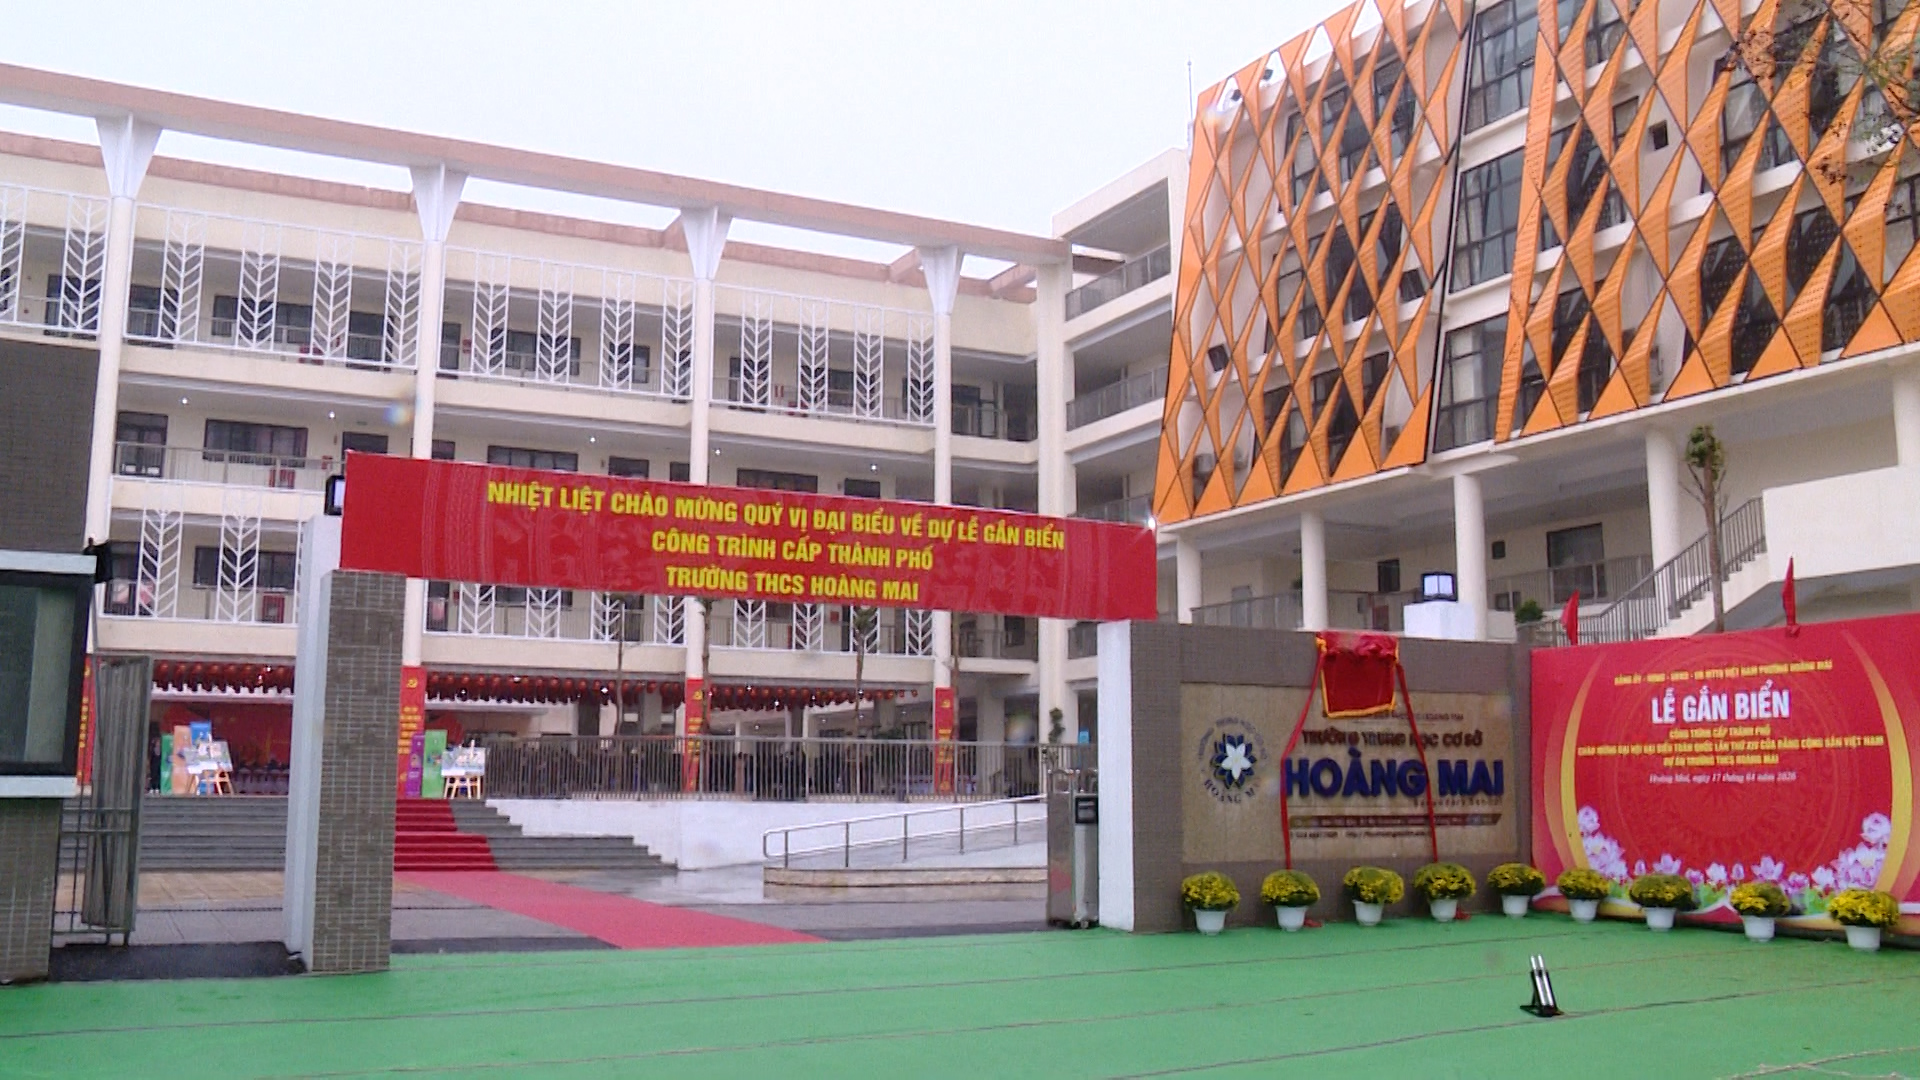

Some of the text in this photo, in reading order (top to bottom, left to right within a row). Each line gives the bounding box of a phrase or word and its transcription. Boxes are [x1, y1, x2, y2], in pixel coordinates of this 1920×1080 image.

[488, 481, 1065, 550] NHIỆT LIỆT CHÀO MỪNG QUÝ VỊ ĐẠI BIỂU VỀ DỰ LỄ GẮN BIỂN
[652, 528, 934, 570] CÔNG TRÌNH CẤP THÀNH PHỐ
[666, 564, 919, 601] TRƯỜNG THCS HOÀNG MAI
[1651, 679, 1790, 724] LỄ GẮN BIỂN
[1302, 726, 1360, 747] TRƯỜNG
[1361, 730, 1407, 747] TRUNG
[1442, 732, 1463, 747] CƠ
[1464, 729, 1484, 747] SỞ
[1285, 746, 1504, 797] HOÀNG MAI
